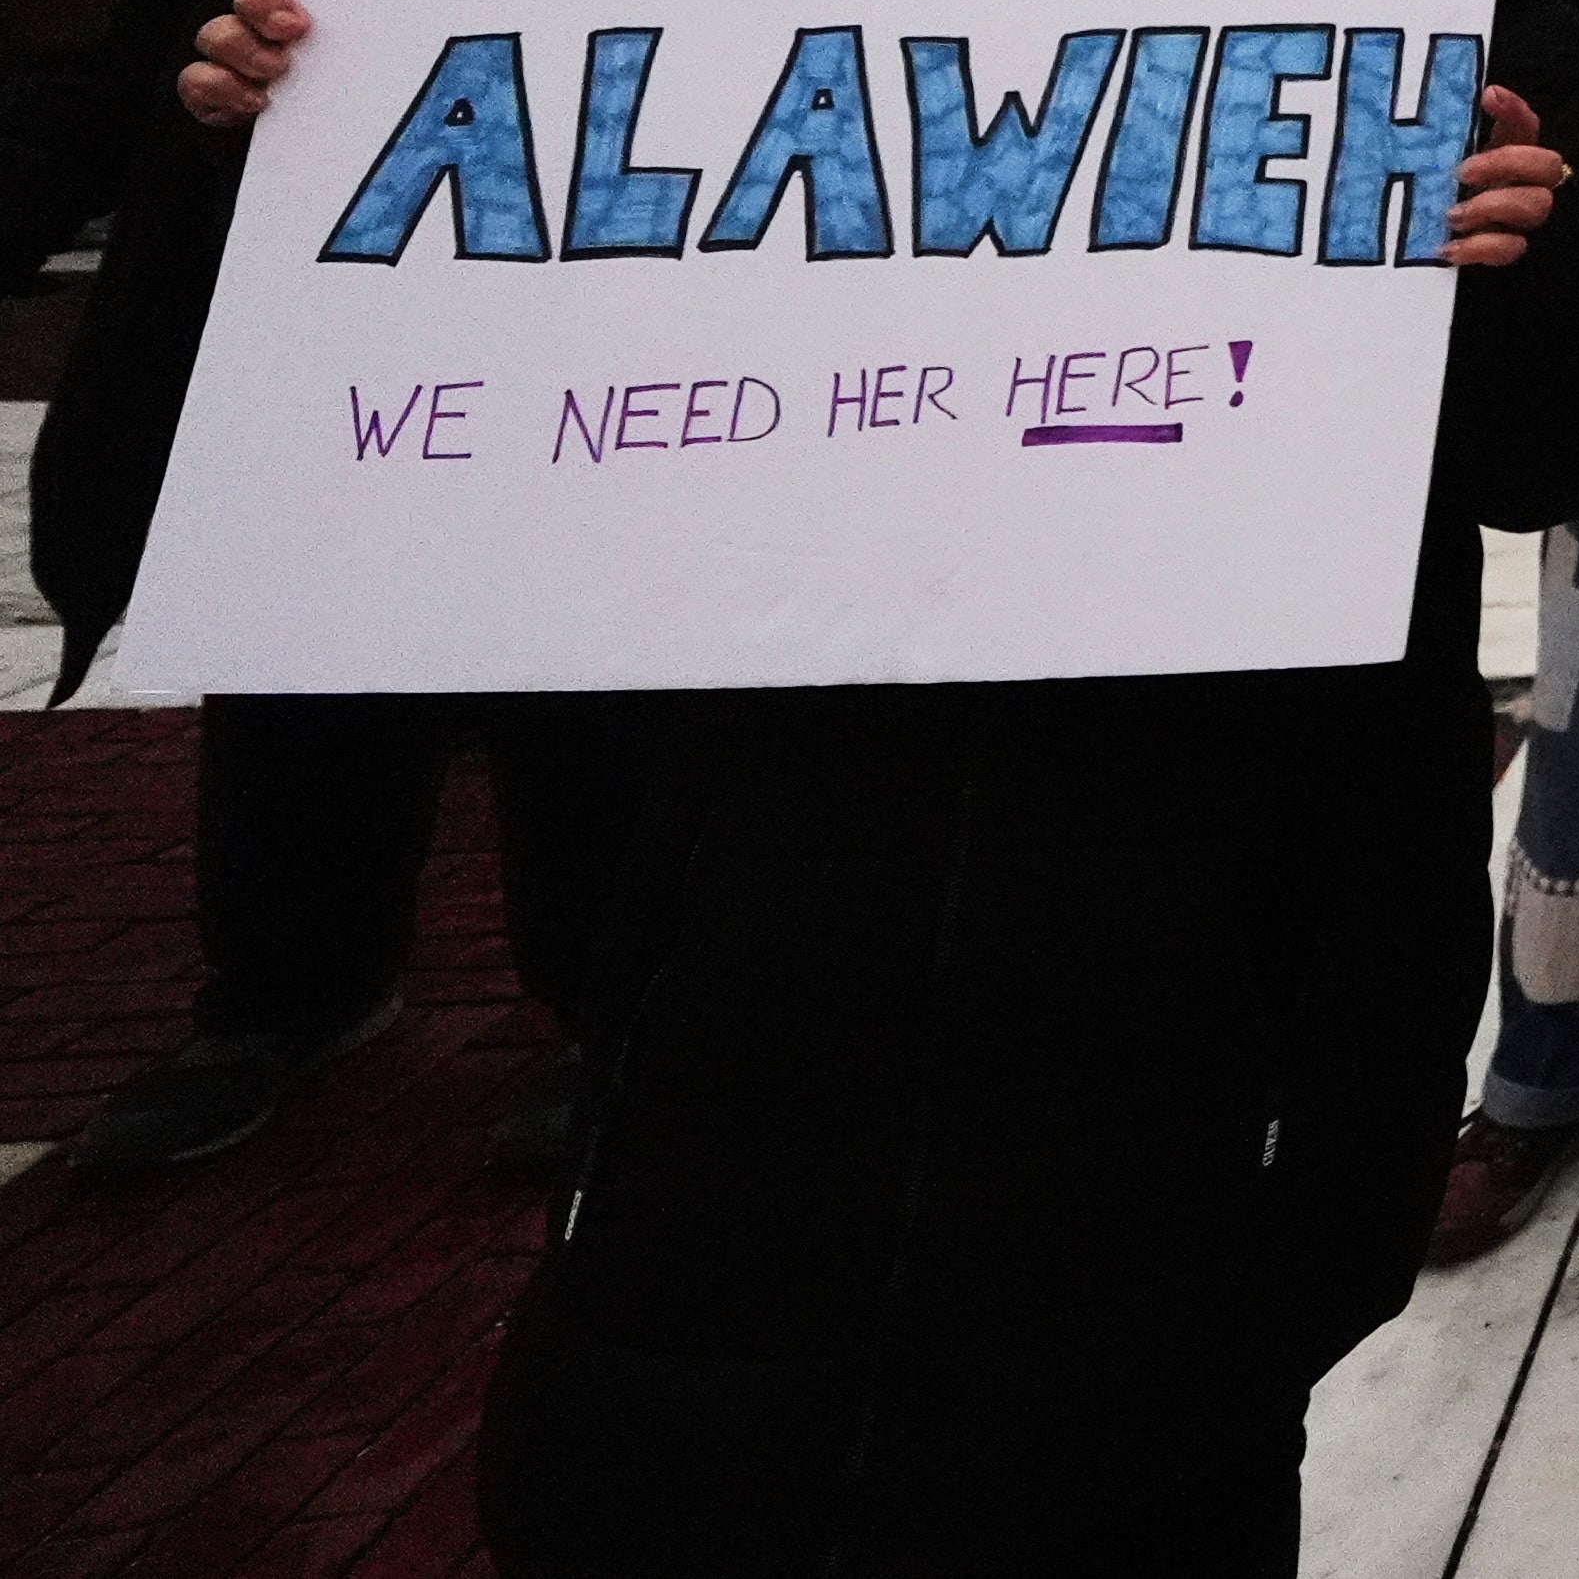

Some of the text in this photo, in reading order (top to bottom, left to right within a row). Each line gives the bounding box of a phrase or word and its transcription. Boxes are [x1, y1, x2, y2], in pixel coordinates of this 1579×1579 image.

[318, 23, 1484, 267] ALAWIEH
[349, 339, 1253, 463] WE NEED HER HERE!
